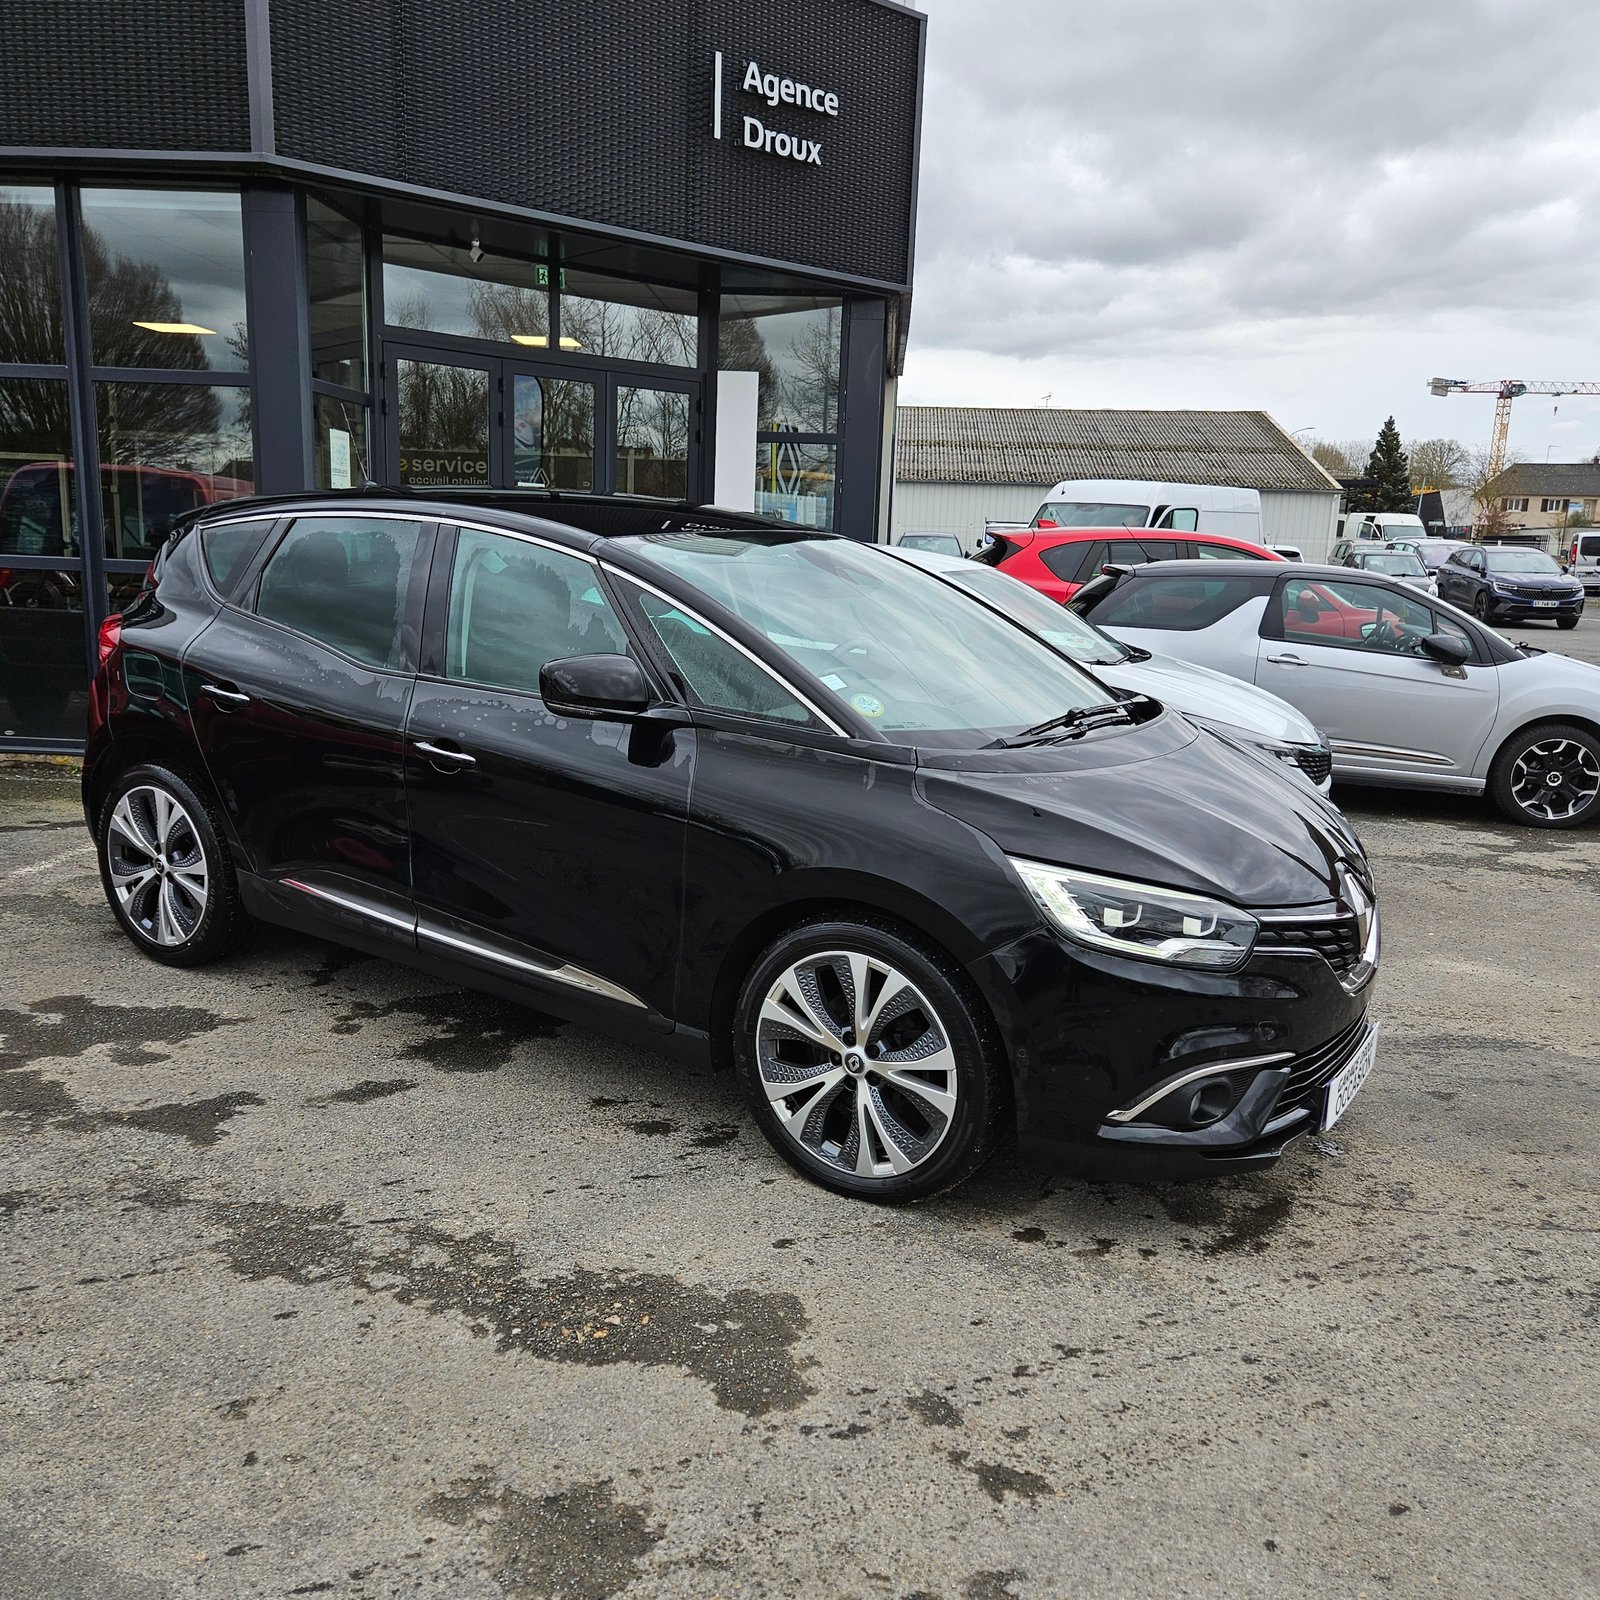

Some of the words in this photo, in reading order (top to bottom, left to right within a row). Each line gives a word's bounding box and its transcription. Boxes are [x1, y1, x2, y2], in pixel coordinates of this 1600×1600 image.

[743, 61, 839, 116] Agence
[743, 116, 822, 166] Droux
[409, 475, 449, 484] accueil
[452, 477, 487, 485] atelier
[412, 456, 487, 473] service
